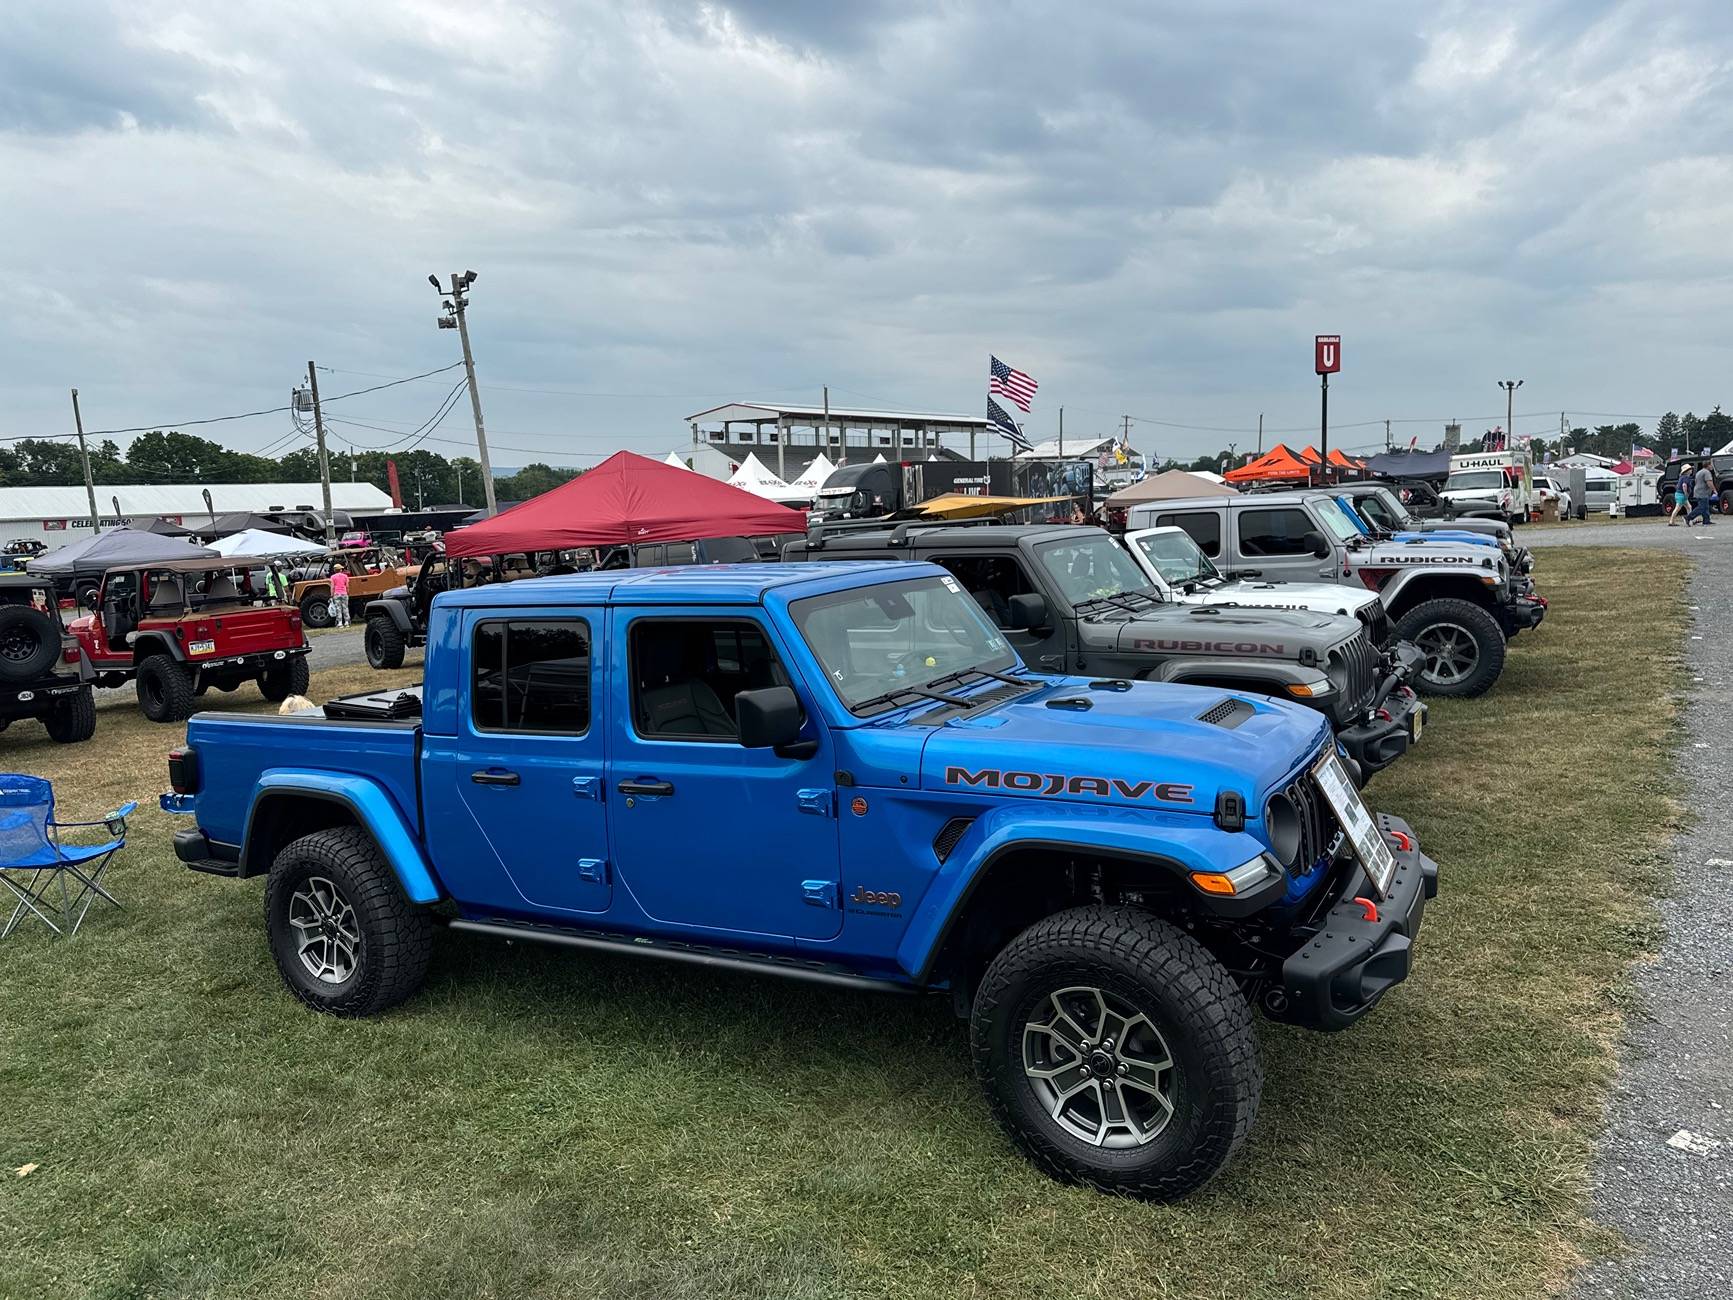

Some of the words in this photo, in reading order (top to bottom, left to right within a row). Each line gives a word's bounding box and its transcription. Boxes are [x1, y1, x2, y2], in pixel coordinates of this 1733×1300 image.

[1323, 345, 1334, 367] U
[1460, 459, 1504, 468] U-HAUL
[72, 518, 120, 528] CELEBATING
[1380, 556, 1474, 564] RUBICON
[1134, 638, 1284, 654] RUBICON
[945, 766, 1194, 803] MOJAVE
[850, 885, 902, 907] Jeep
